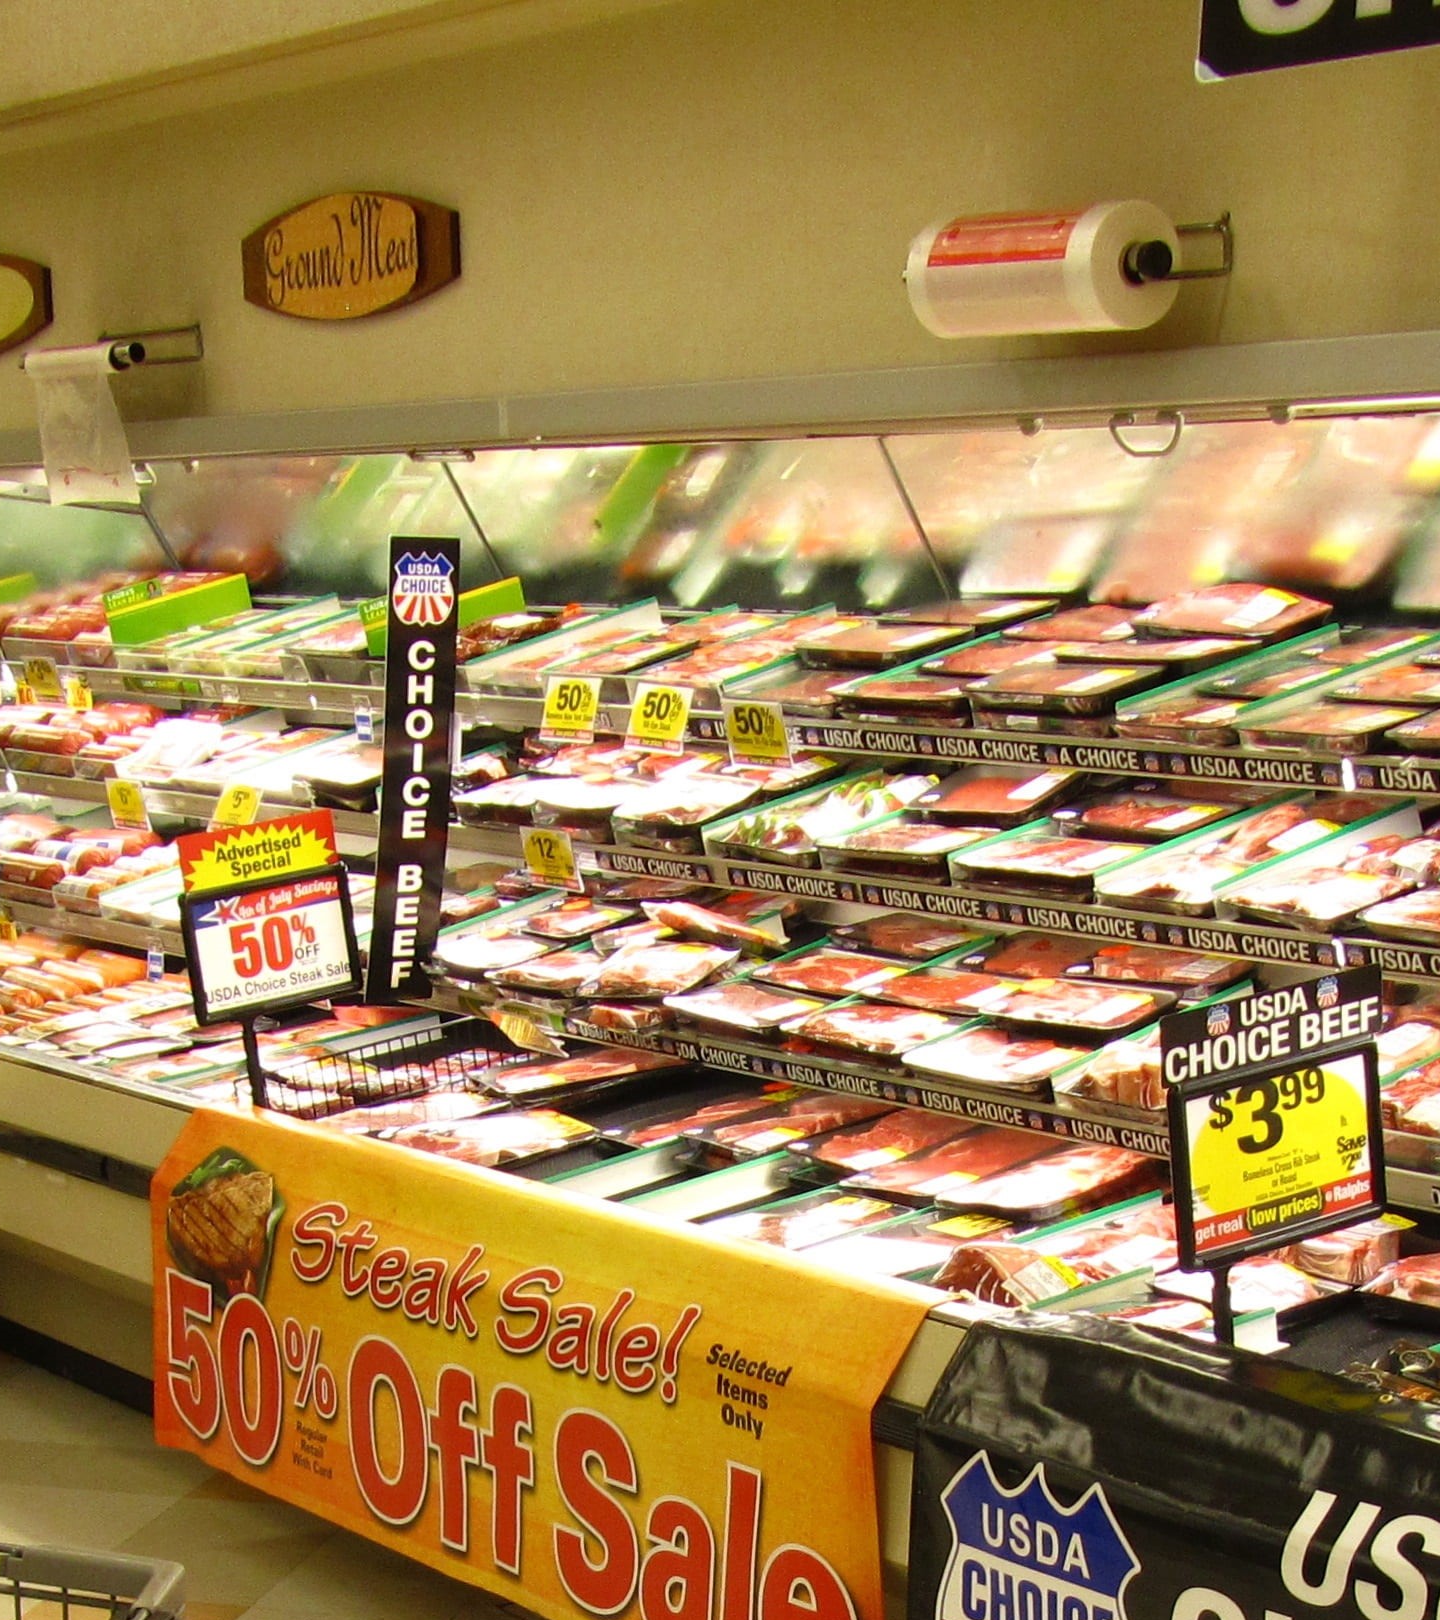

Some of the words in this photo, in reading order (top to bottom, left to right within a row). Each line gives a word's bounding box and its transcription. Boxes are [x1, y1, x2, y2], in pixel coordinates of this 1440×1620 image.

[265, 214, 343, 306] Ground
[349, 196, 418, 288] Meat
[407, 562, 441, 575] USDA
[400, 577, 446, 595] CHOICE
[401, 640, 436, 840] CHOICE
[824, 730, 862, 749] USDA
[937, 738, 976, 757] USDA
[980, 741, 1040, 763] CHOICE
[1077, 748, 1139, 770] CHOICE
[1191, 756, 1238, 777] USDA
[1243, 759, 1316, 784] CHOICE
[1380, 767, 1436, 791] USDA
[215, 833, 302, 864] Advertised
[231, 853, 292, 878] Special
[612, 855, 646, 873] USDA
[647, 860, 692, 880] CHOICE
[269, 889, 293, 911] July
[295, 880, 338, 901] Savings
[747, 873, 782, 892] USDA
[784, 878, 837, 898] CHOICE
[883, 888, 923, 910] USDA
[927, 895, 982, 918] CHOICE
[390, 864, 423, 989] BEEF
[1028, 907, 1071, 930] USDA
[1075, 914, 1138, 939] CHOICE
[229, 912, 316, 978] 50%
[295, 943, 321, 961] OFF
[1187, 928, 1235, 951] USDA
[1240, 935, 1312, 962] CHOICE
[1370, 948, 1425, 974] USDA
[206, 985, 242, 1006] USDA
[244, 975, 287, 997] Choice
[290, 967, 323, 986] Steak
[327, 961, 350, 976] Sale
[1240, 987, 1308, 1027] USDA
[614, 1029, 660, 1050] CHOICE
[1165, 1019, 1291, 1084] CHOICE
[1299, 996, 1379, 1050] BEEF
[699, 1046, 749, 1071] CHOICE
[787, 1063, 824, 1087] USDA
[826, 1072, 879, 1096] CHOICE
[921, 1090, 964, 1113] USDA
[967, 1100, 1025, 1126] CHOICE
[1071, 1120, 1116, 1144] USDA
[1121, 1131, 1170, 1155] CHOIC
[1337, 1133, 1366, 1156] Save
[1243, 1164, 1273, 1182] Boneless
[1274, 1158, 1292, 1174] Cross
[1293, 1155, 1303, 1168] Rib
[1279, 1172, 1297, 1187] Roast
[1195, 1223, 1215, 1248] get
[1217, 1216, 1243, 1239] real
[1333, 1178, 1370, 1202] Ralphs
[289, 1202, 484, 1340] Steak
[494, 1267, 702, 1404] Sale!
[166, 1266, 338, 1467] 50%
[706, 1342, 793, 1389] Selected
[716, 1373, 769, 1411] Items
[294, 1420, 327, 1444] Regular
[720, 1404, 764, 1441] Only
[299, 1438, 324, 1459] Retail
[348, 1334, 534, 1575] Off
[292, 1453, 313, 1470] With
[314, 1459, 332, 1480] Card
[979, 1502, 1091, 1580] USDA
